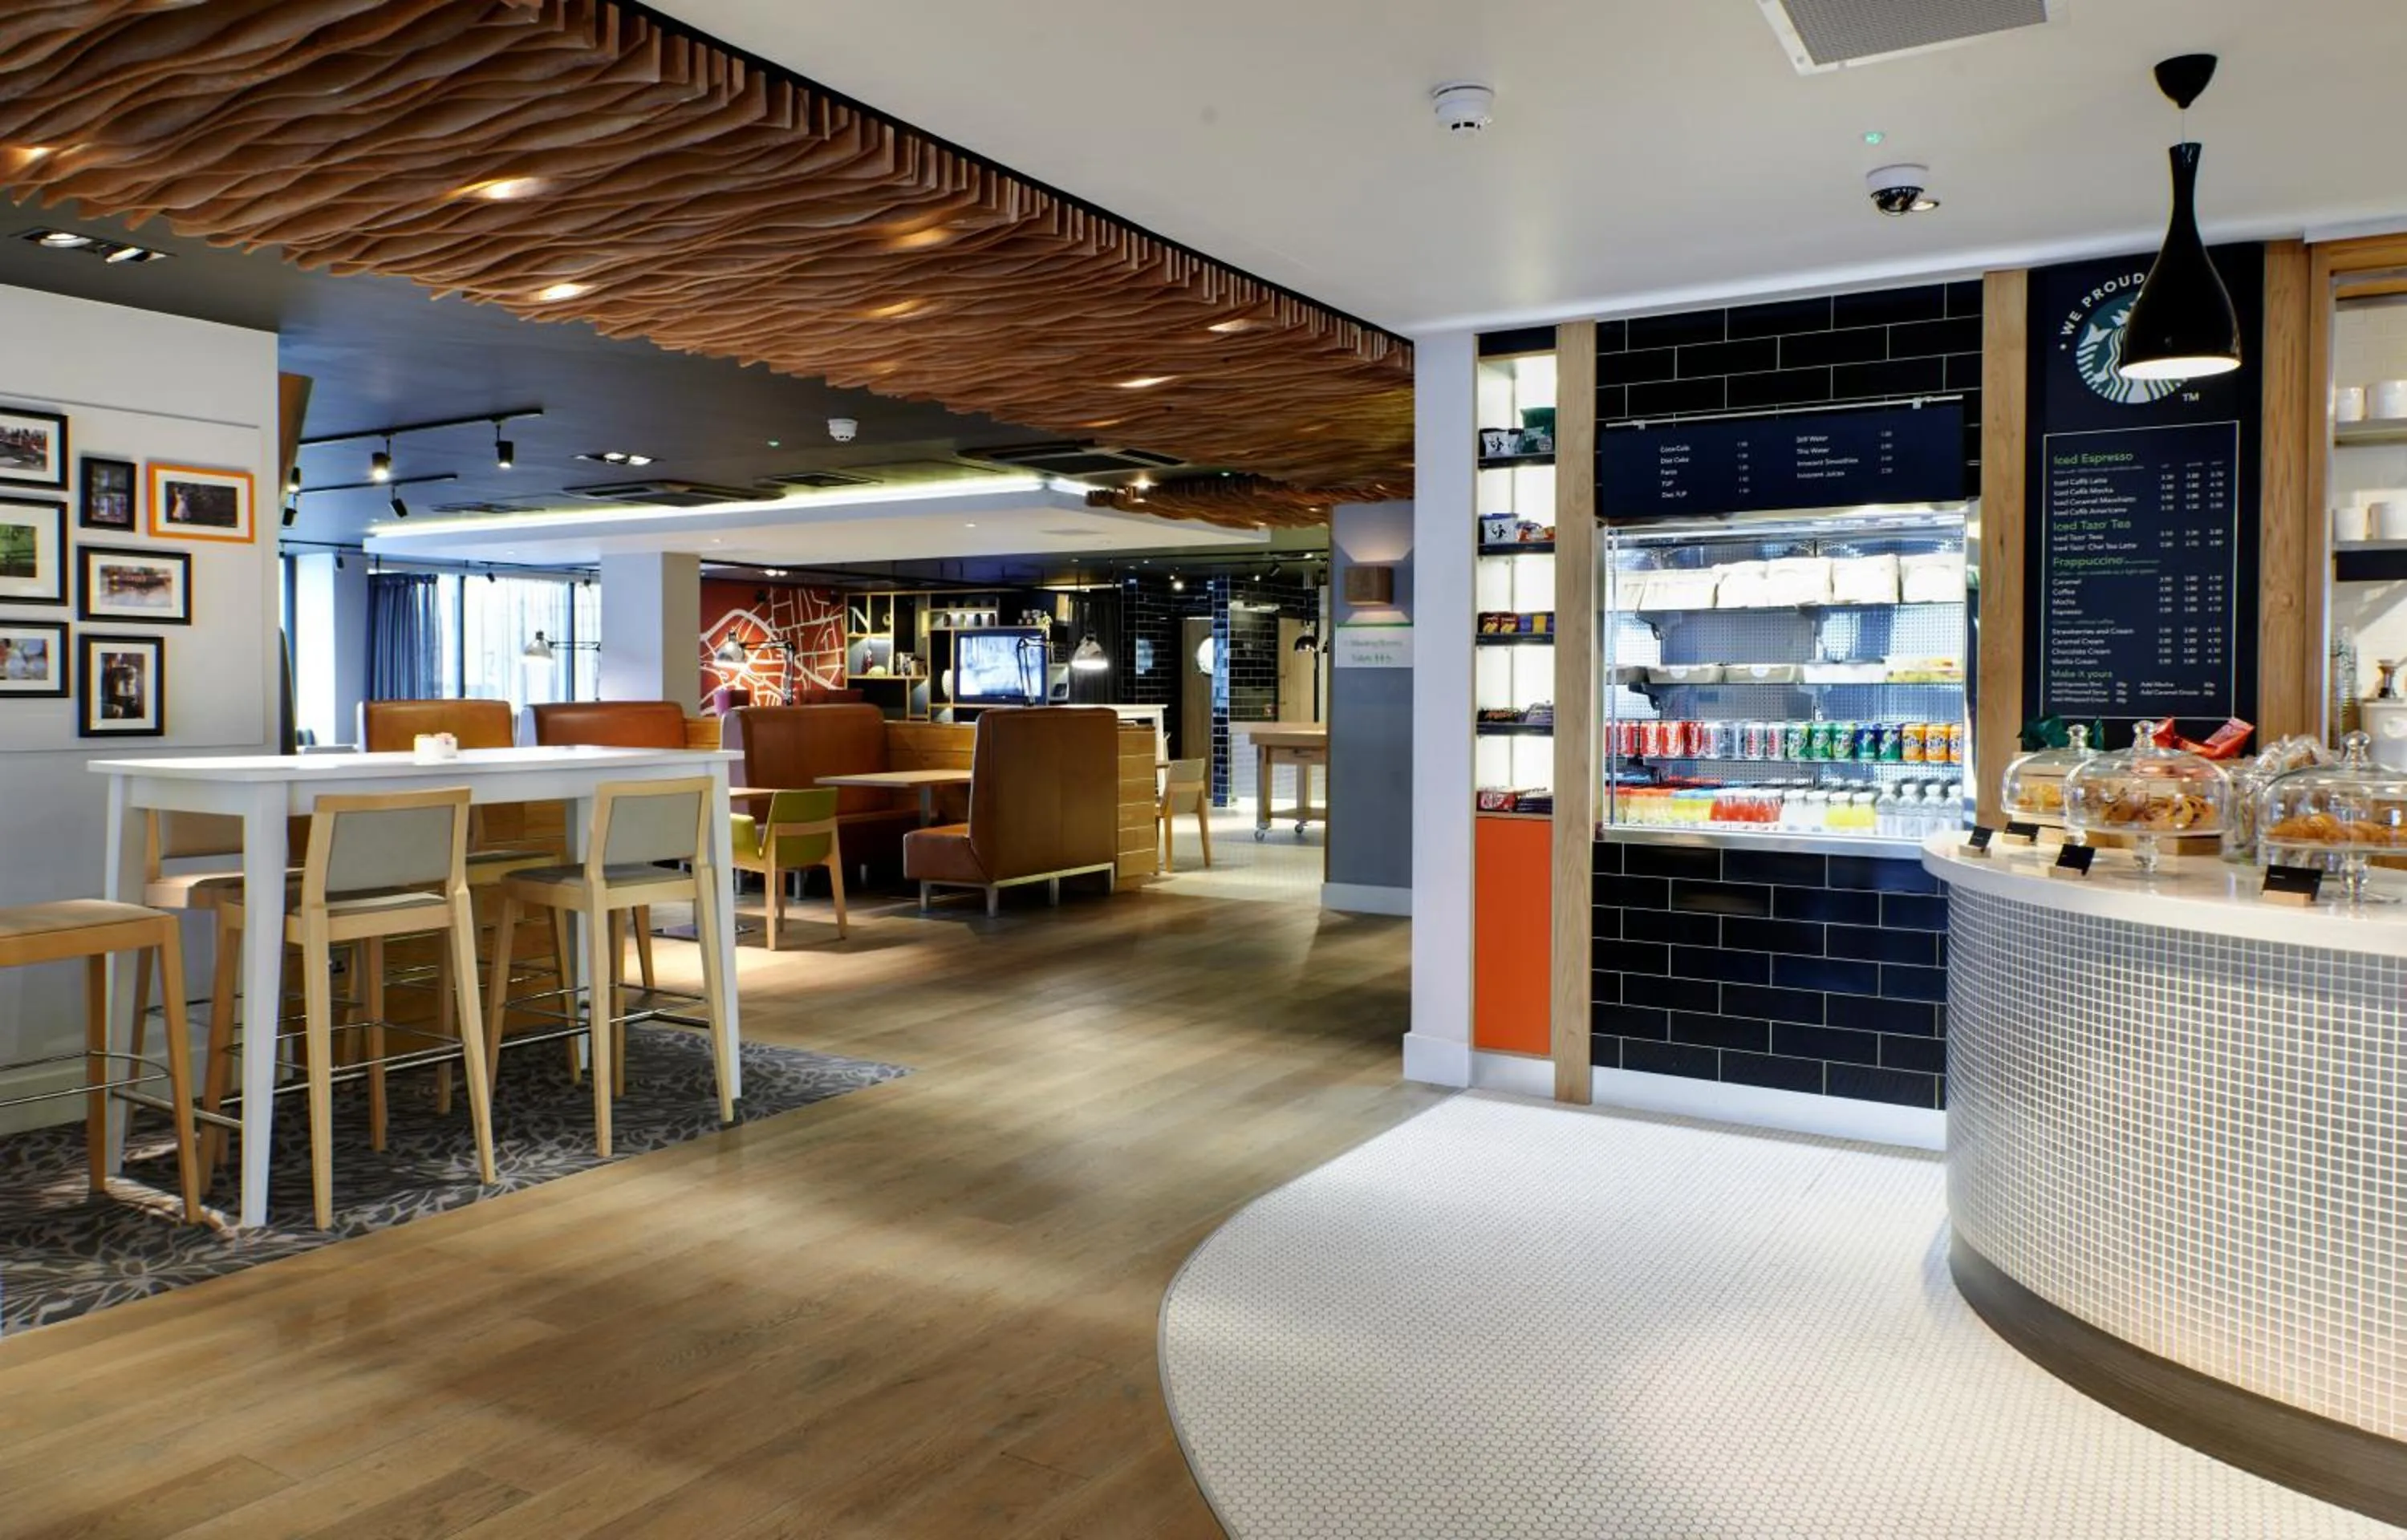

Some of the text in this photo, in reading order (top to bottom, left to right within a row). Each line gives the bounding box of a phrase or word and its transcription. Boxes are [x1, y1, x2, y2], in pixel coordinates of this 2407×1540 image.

[2060, 273, 2145, 335] WE PROUD
[2182, 392, 2199, 402] TM
[2054, 452, 2133, 465] Iced Espresso
[2054, 521, 2077, 531] Iced
[2111, 518, 2132, 529] Tea
[2052, 578, 2082, 586] Caramel
[2052, 588, 2076, 596] Coffee
[2052, 647, 2111, 655] Chocolate Cream
[2074, 657, 2098, 665] Cream
[2050, 669, 2076, 678] Make
[2087, 671, 2113, 679] yours
